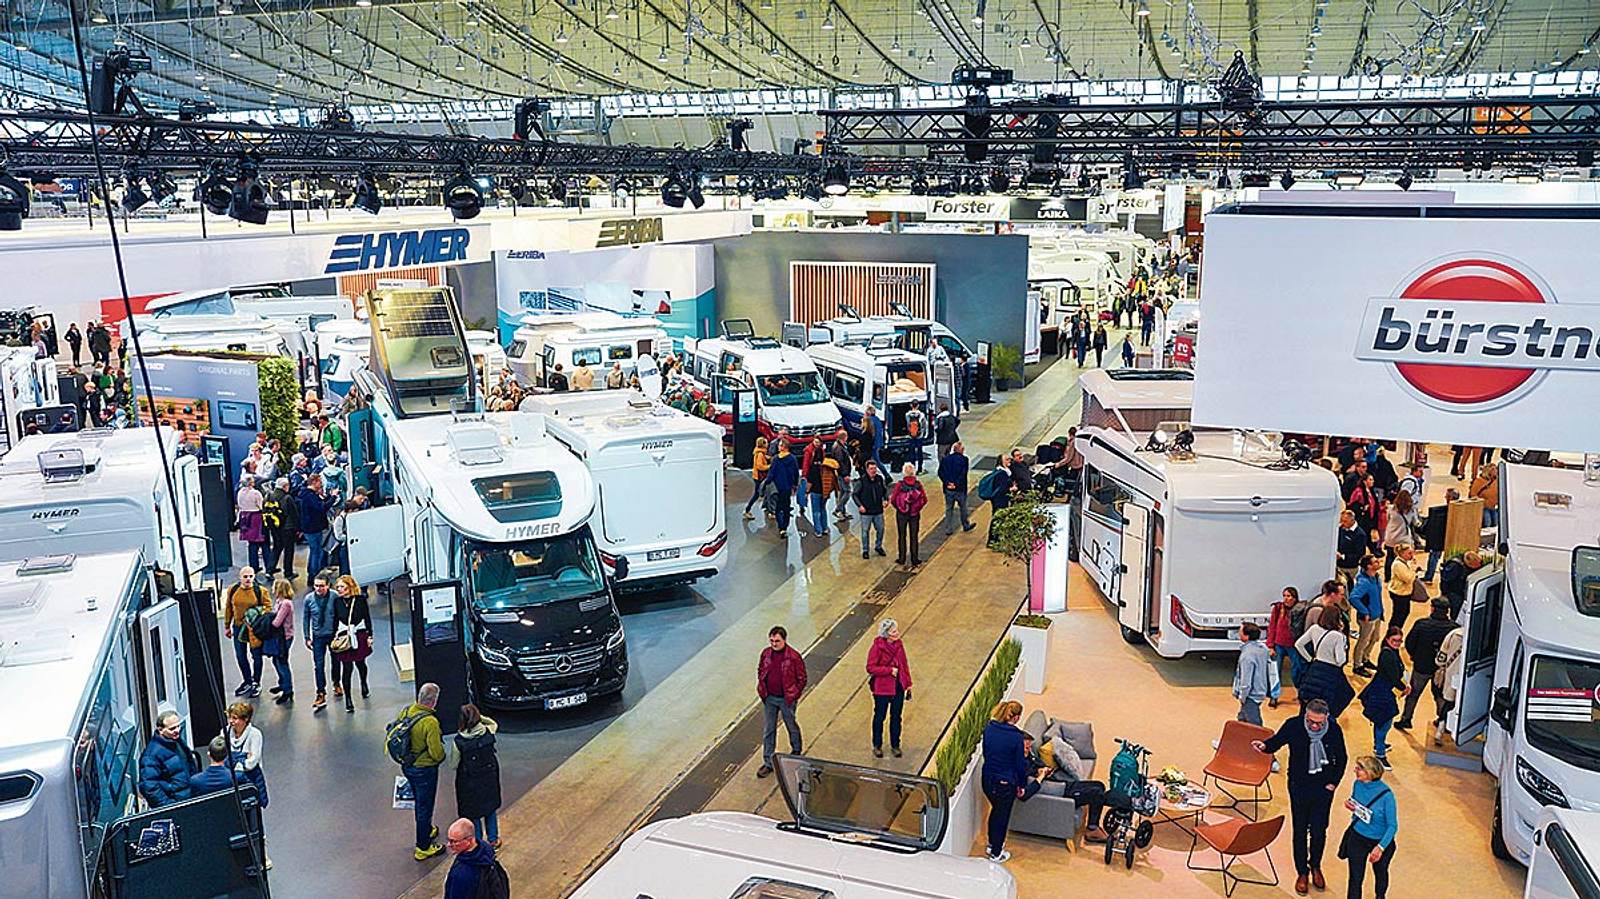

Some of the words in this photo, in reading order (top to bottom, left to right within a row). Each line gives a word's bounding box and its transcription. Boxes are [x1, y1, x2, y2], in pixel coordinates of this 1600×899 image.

[932, 200, 995, 213] Forster
[1038, 210, 1069, 218] LAIKA
[350, 228, 470, 271] HYMER
[1373, 307, 1600, 359] bürstn
[641, 440, 673, 450] HYMER
[32, 509, 80, 519] HYMER
[505, 522, 560, 539] HYMER
